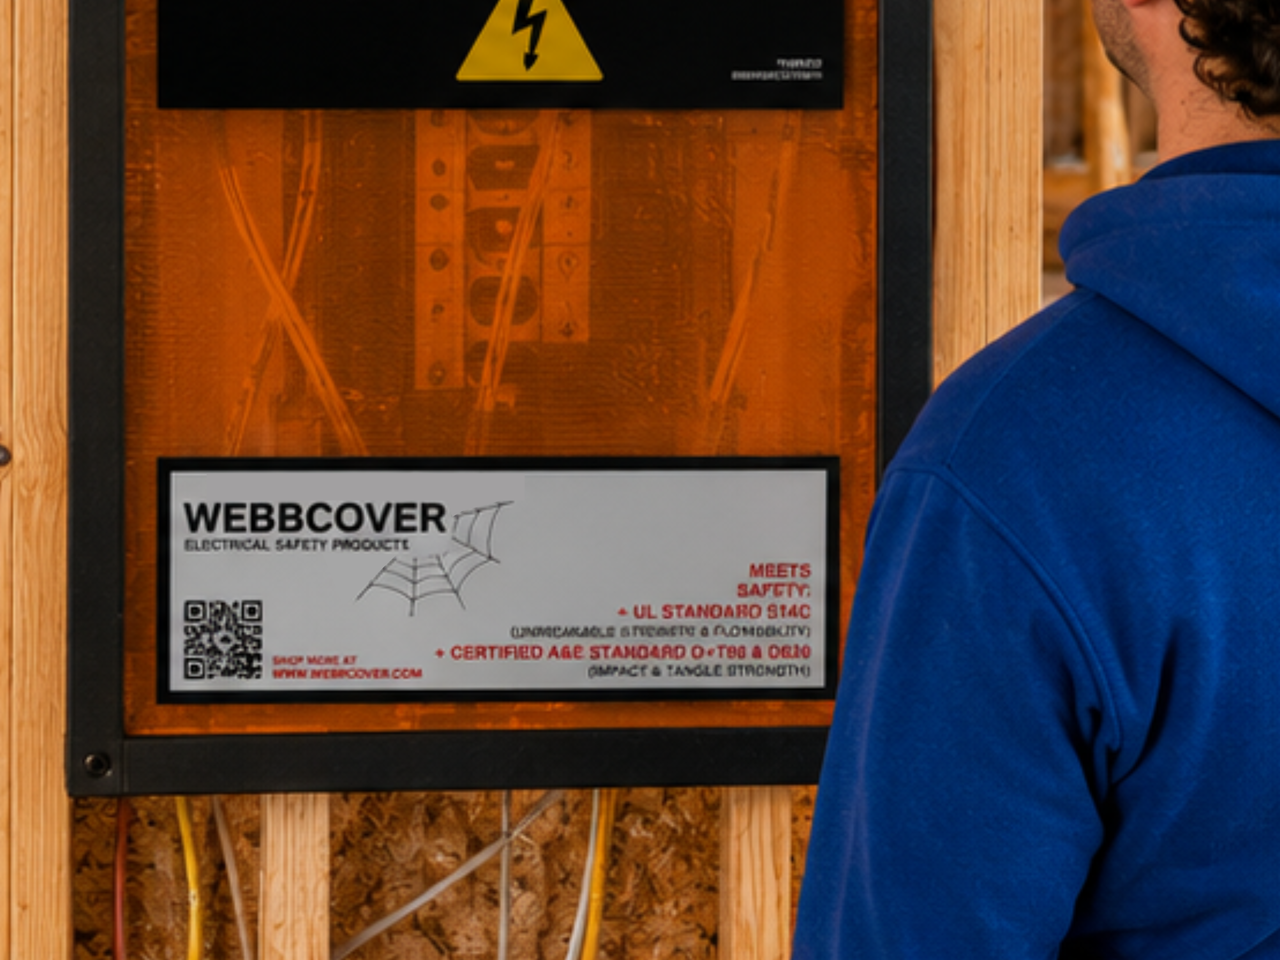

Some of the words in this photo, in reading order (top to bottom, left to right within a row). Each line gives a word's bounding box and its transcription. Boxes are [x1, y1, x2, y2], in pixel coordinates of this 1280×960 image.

[183, 501, 447, 535] WEBBCOVER
[183, 538, 270, 552] ELECTRICAL
[275, 538, 329, 552] SAFETY
[749, 562, 812, 579] MEETS
[633, 604, 658, 620] UL
[661, 604, 763, 620] STANDARD
[450, 644, 544, 661] CERTIFIED
[589, 644, 686, 661] STANDARD
